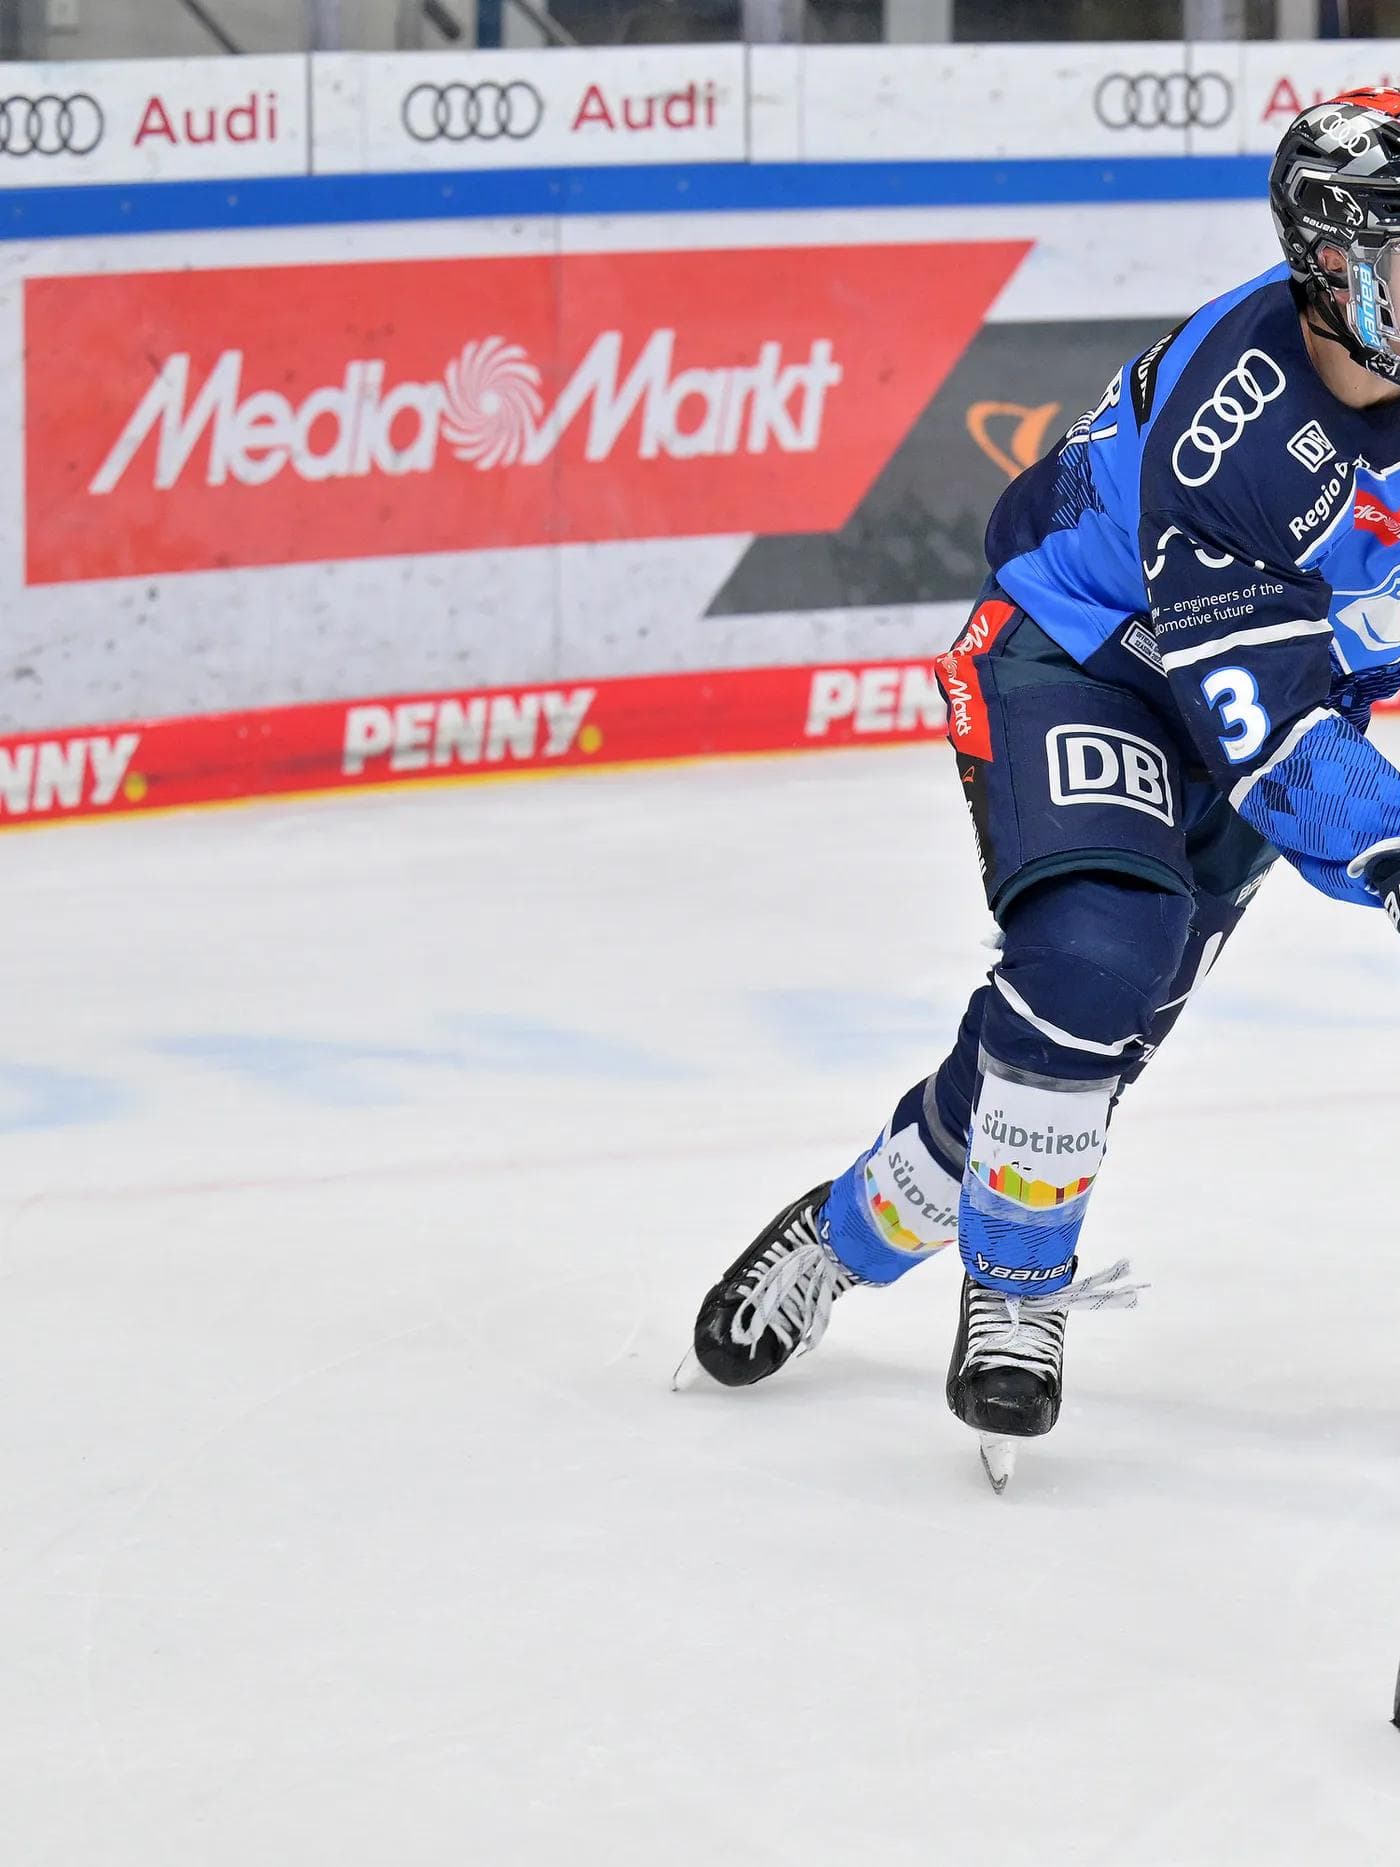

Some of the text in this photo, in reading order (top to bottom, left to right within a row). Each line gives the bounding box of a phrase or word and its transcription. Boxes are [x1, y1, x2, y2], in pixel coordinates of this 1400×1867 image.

[134, 92, 279, 148] Audi
[571, 81, 717, 134] Audi
[1295, 430, 1331, 464] DB
[1289, 478, 1341, 542] Regio
[1174, 589, 1240, 613] engineers
[1242, 584, 1257, 599] of
[1257, 584, 1284, 597] the
[1213, 603, 1255, 621] future
[1200, 666, 1272, 764] 3
[1065, 737, 1164, 805] DB
